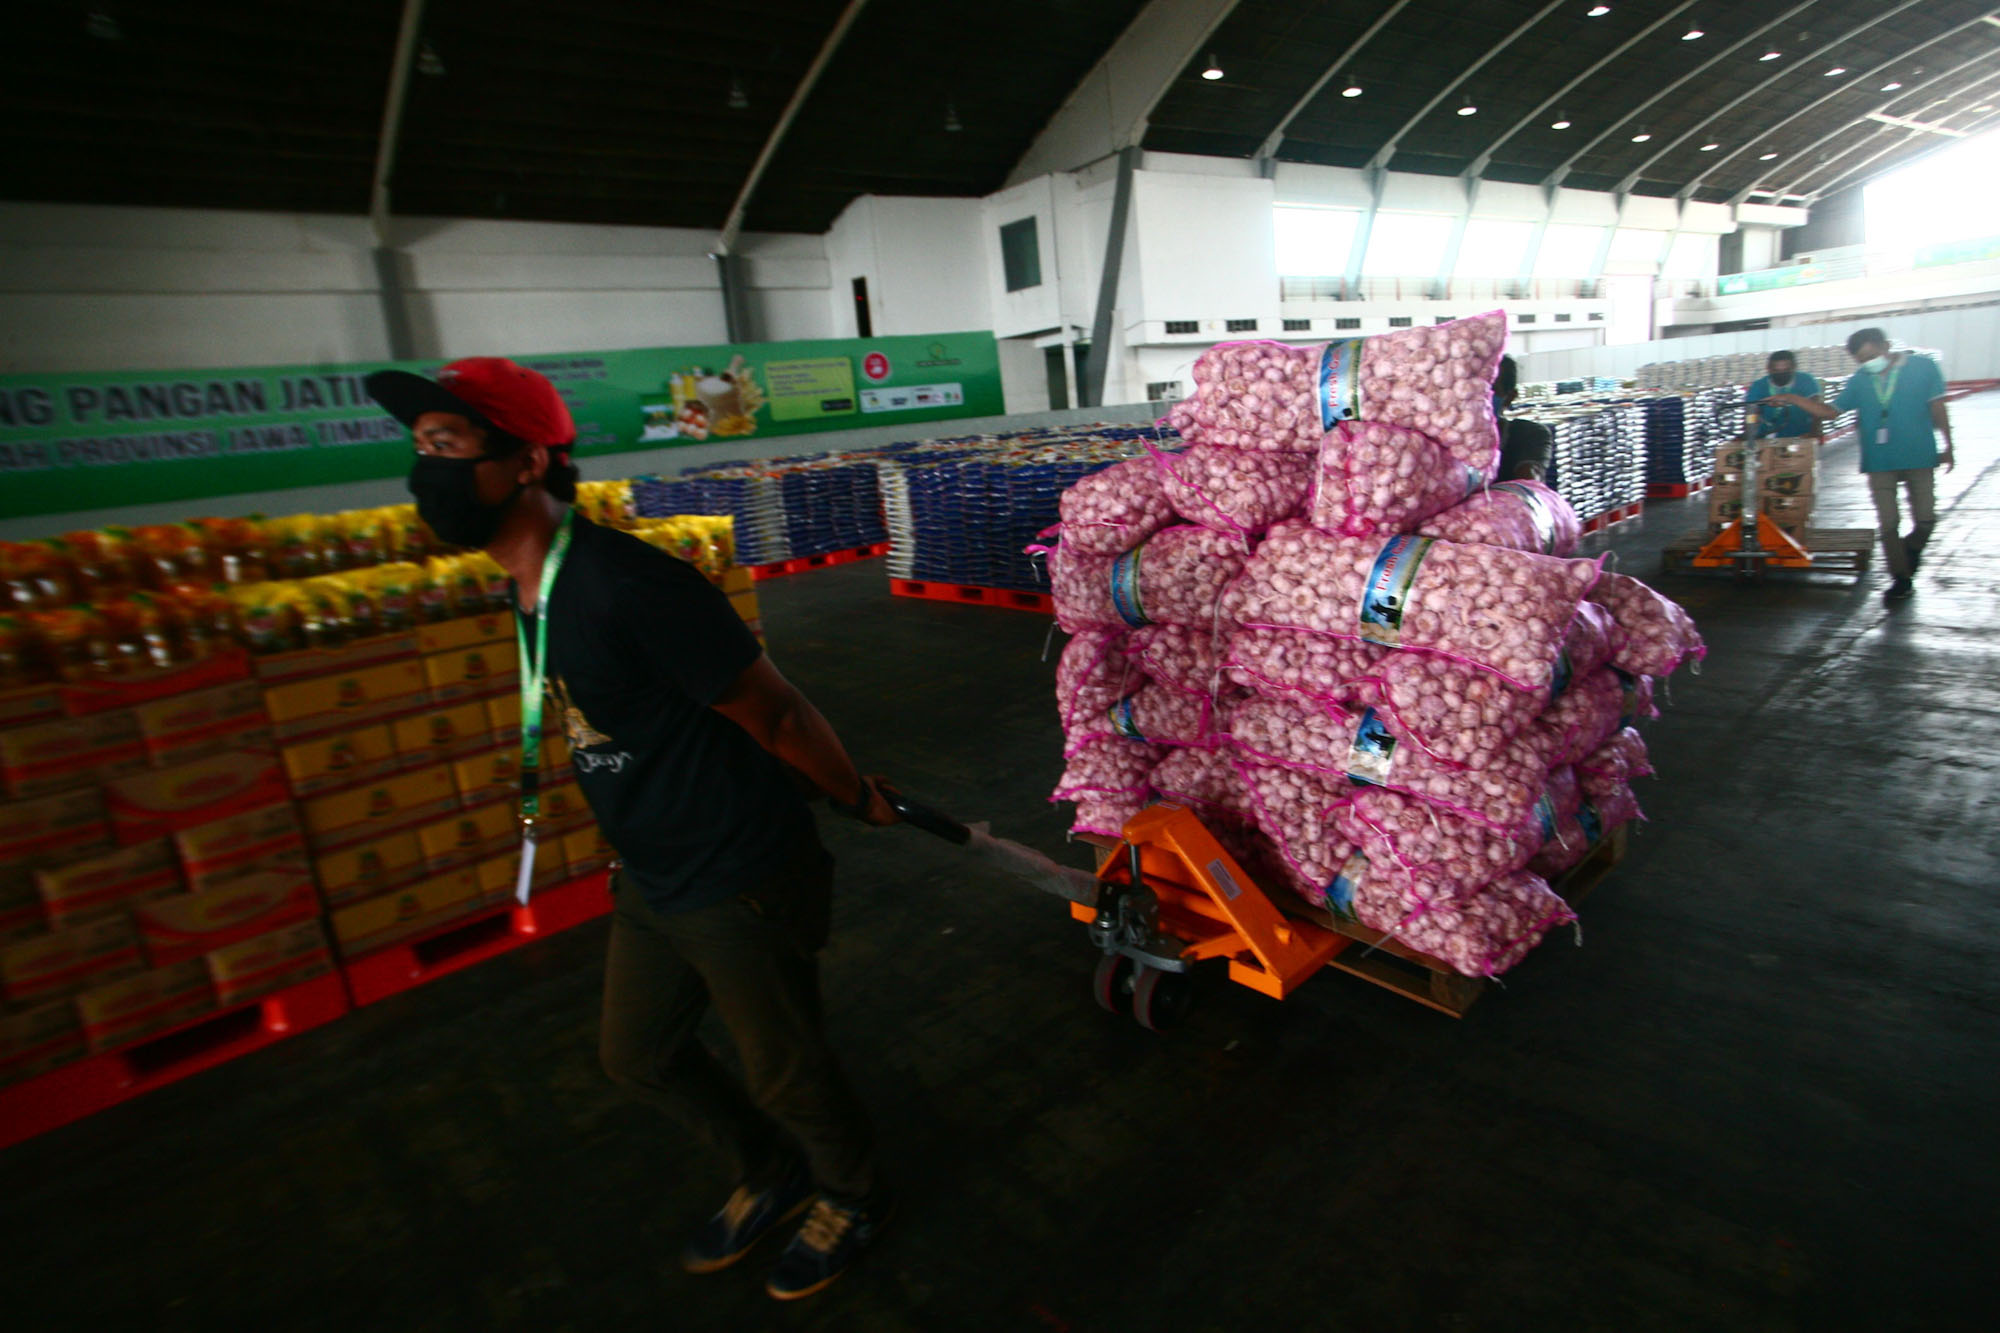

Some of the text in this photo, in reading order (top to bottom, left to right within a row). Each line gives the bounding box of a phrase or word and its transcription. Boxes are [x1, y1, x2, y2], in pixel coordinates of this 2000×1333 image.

[64, 378, 266, 423] PANGAN
[278, 373, 374, 411] JATI
[56, 428, 219, 467] PROVINSI
[226, 423, 312, 454] JAWA
